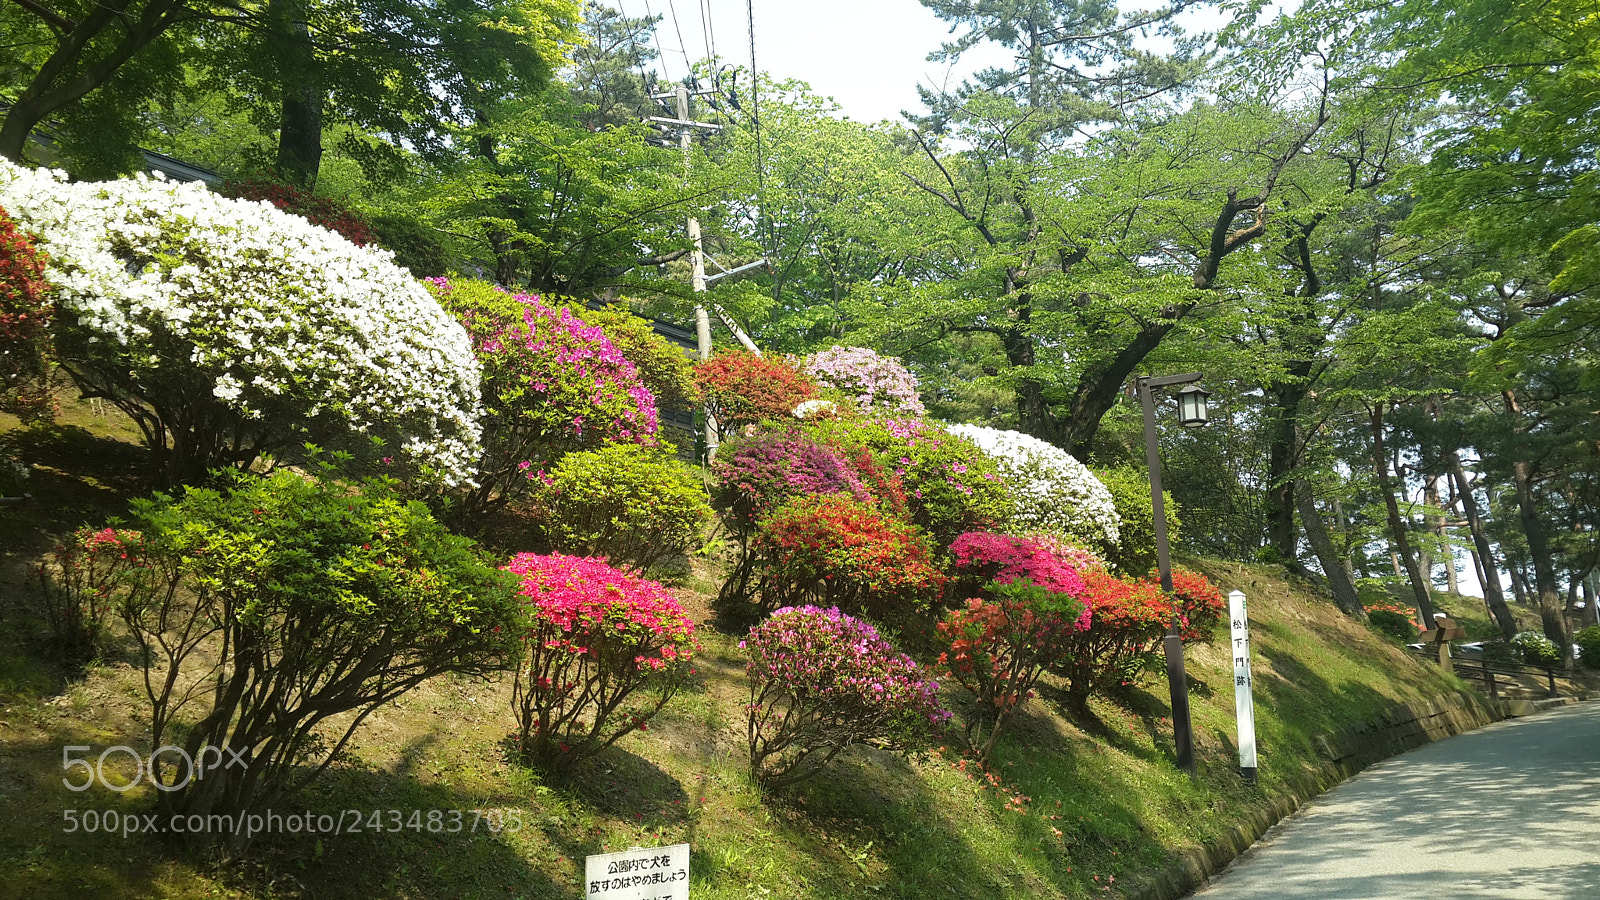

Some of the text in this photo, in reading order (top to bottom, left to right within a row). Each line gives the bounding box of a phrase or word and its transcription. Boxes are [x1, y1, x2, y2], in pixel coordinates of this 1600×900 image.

[1233, 619, 1245, 686] 松下門跡
[608, 854, 671, 874] 公園内で犬を
[589, 869, 687, 894] 放すのはやめましょう
